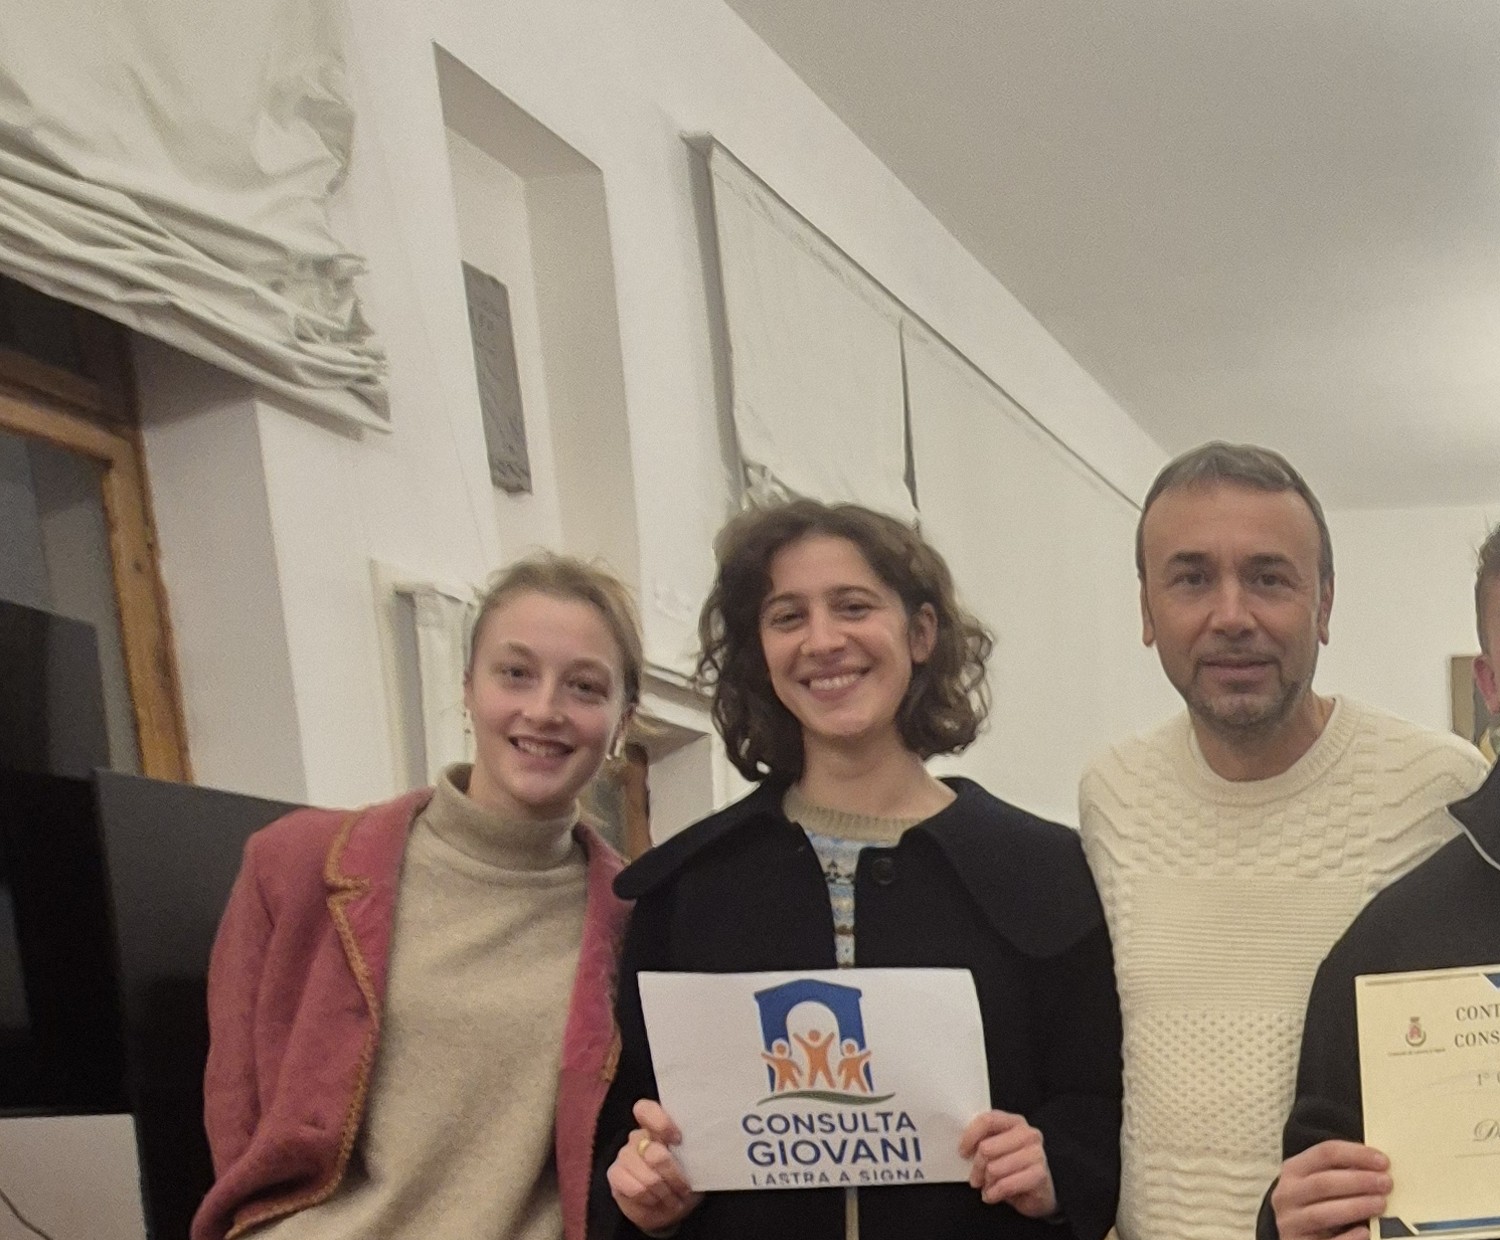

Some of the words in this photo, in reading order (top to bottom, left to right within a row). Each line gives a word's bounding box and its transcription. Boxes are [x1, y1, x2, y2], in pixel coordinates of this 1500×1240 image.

[741, 1111, 917, 1135] CONSULTA
[747, 1137, 922, 1167] GIOVANI
[751, 1171, 830, 1186] LASTRA
[839, 1170, 850, 1183] A
[859, 1168, 925, 1182] SIGNA
